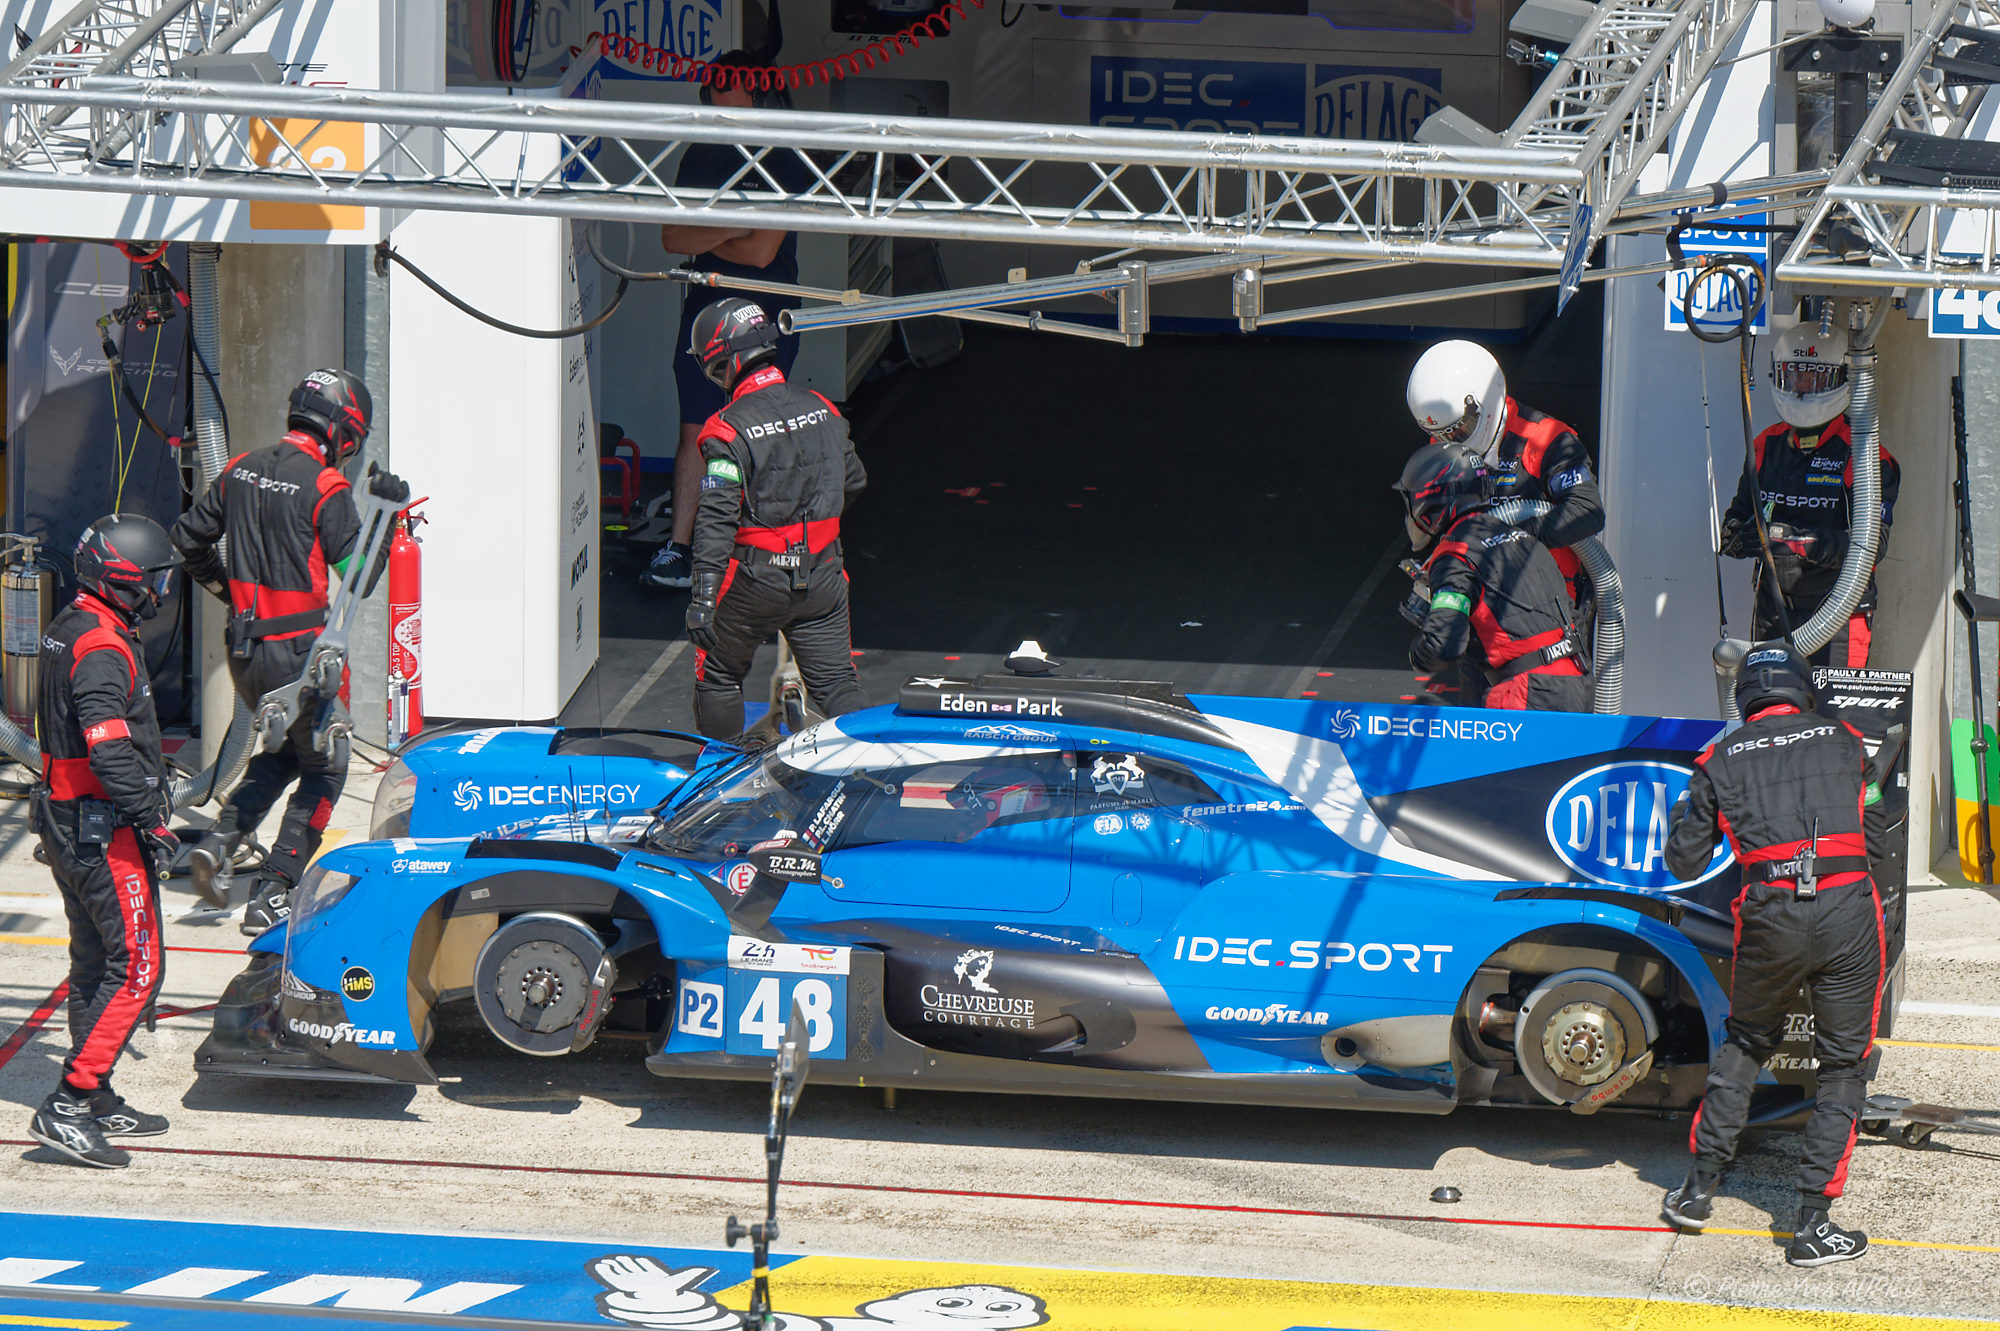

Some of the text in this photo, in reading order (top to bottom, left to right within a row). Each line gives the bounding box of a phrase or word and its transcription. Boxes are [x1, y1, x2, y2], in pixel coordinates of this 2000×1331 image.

[602, 0, 714, 60] DELAGE
[1828, 669, 1857, 678] PAULY
[1868, 671, 1912, 681] PARTNER
[1832, 683, 1906, 693] www.paulyundpartner.de
[940, 693, 1063, 717] Eden Park
[1827, 695, 1905, 709] spark
[963, 732, 1058, 743] RAISCH GROUP
[1428, 718, 1523, 742] ENERGY
[1182, 800, 1306, 818] fenetre24.com
[1094, 817, 1122, 832] FIA
[408, 859, 451, 874] atawey
[738, 872, 749, 890] E
[800, 962, 838, 970] TotalEnergies
[343, 977, 373, 992] HMS
[682, 988, 718, 1030] P2
[738, 977, 834, 1052] 48
[1205, 1004, 1329, 1026] GOODYEAR
[922, 1011, 1036, 1030] COURTAGE
[289, 1018, 396, 1045] GOODYEAR
